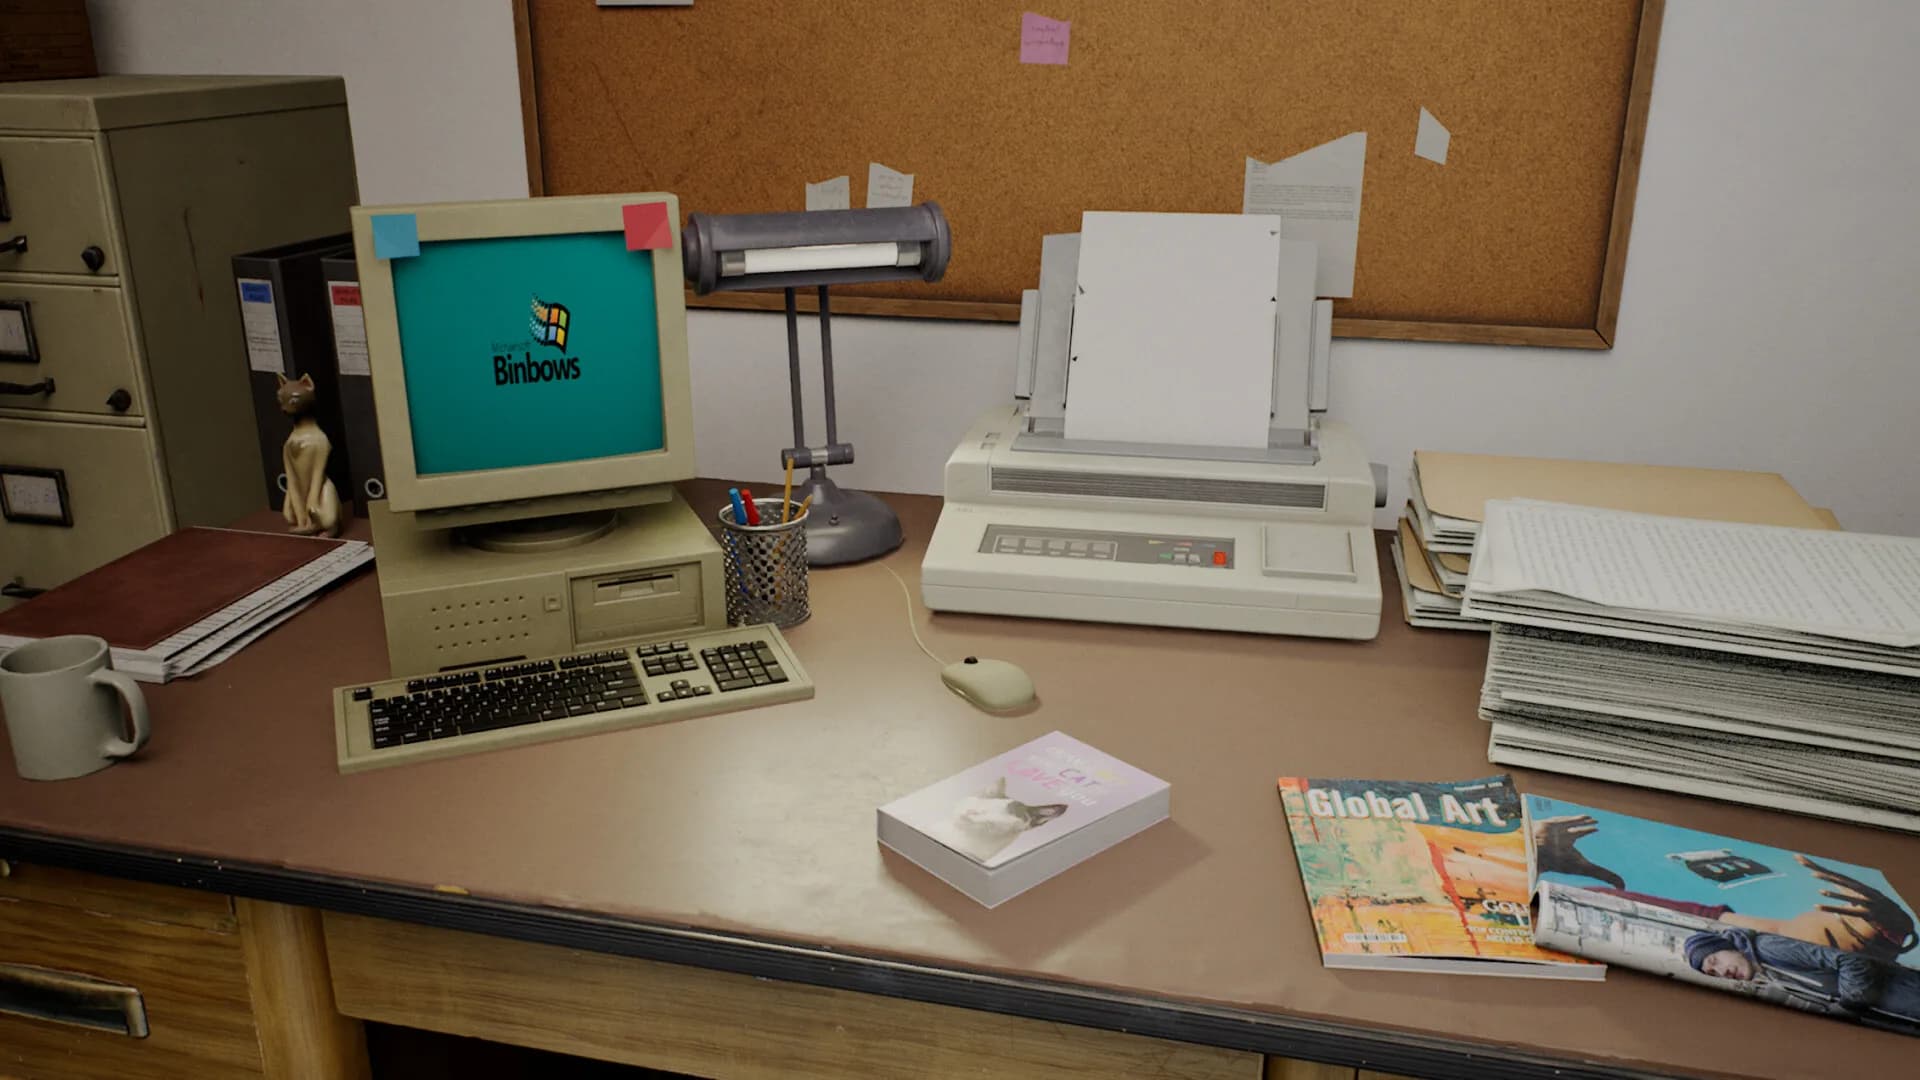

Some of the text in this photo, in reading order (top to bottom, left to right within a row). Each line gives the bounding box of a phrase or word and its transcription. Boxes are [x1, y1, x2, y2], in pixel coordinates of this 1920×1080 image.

[493, 351, 581, 386] Binbows
[1308, 788, 1507, 827] Global Art
